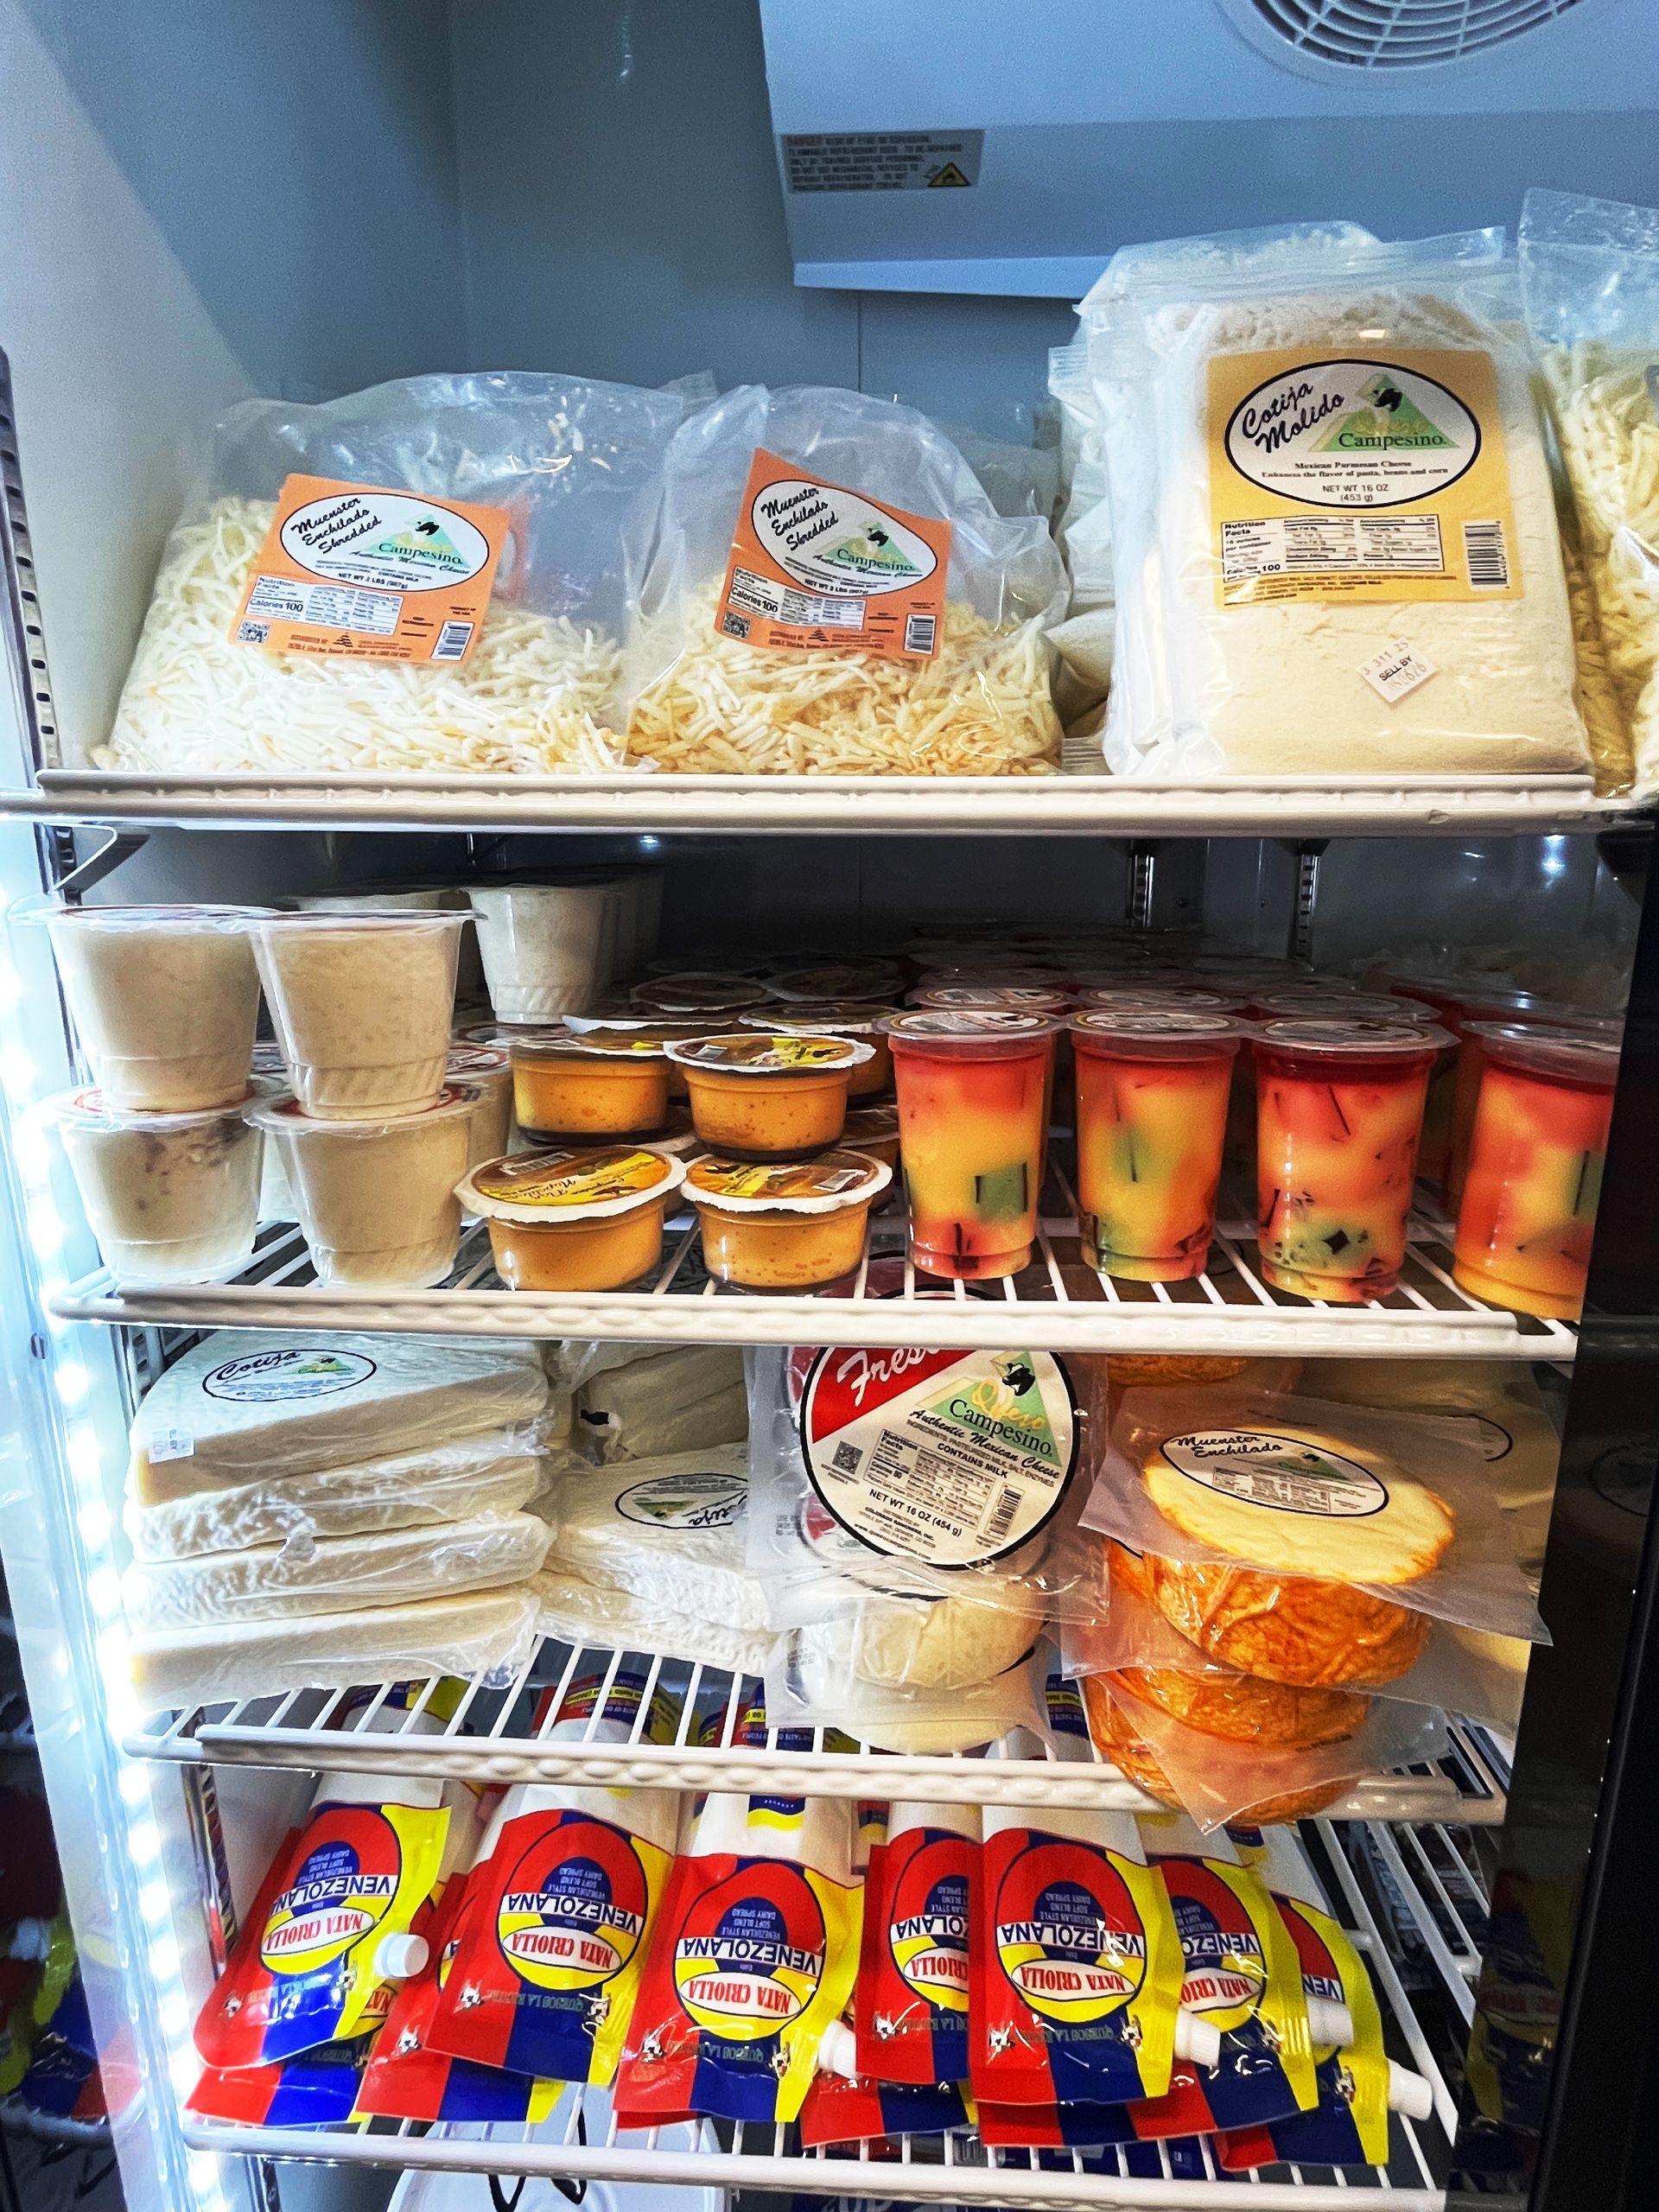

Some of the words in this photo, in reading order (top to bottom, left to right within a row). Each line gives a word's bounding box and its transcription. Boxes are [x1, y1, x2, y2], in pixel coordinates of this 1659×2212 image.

[1242, 381, 1313, 438] Cotija
[1255, 393, 1344, 454] Molido
[1339, 432, 1445, 450] Campesino
[1340, 493, 1362, 503] (453
[1363, 493, 1374, 503] g)
[1362, 484, 1373, 493] 16
[760, 487, 819, 518] Muenster
[291, 498, 360, 534] Muenster
[1224, 520, 1266, 530] Nutrition
[318, 515, 382, 554] Shredded
[786, 512, 839, 551] Shredded
[1225, 528, 1250, 537] Facts
[378, 542, 461, 565] Campesino
[837, 549, 912, 570] Campesino
[338, 572, 351, 581] NET
[353, 574, 365, 582] WT
[372, 576, 385, 586] LBS
[250, 598, 283, 610] Calories
[284, 602, 303, 613] 100
[732, 587, 762, 608] Calories
[762, 600, 779, 613] 100
[1379, 664, 1402, 681] SELL
[1399, 655, 1412, 667] BY
[216, 1351, 301, 1381] Cotija
[950, 1399, 1052, 1457] Campesino
[909, 1408, 966, 1439] Authentic
[969, 1430, 1020, 1463] Mexican
[1021, 1455, 1061, 1479] Cheese
[1171, 1435, 1262, 1447] Muenster
[937, 1442, 984, 1468] CONTAINS
[984, 1463, 1008, 1479] MILK
[1191, 1444, 1283, 1459] Enchilado
[869, 1488, 889, 1503] NET
[889, 1497, 906, 1510] WT
[906, 1504, 917, 1516] 16
[917, 1510, 933, 1523] OZ
[931, 1516, 952, 1533] (454
[951, 1525, 963, 1538] g)
[548, 1884, 567, 1893] STYLE
[560, 1877, 582, 1887] BLEND
[582, 1878, 597, 1889] SOFT
[938, 1886, 961, 1895] SPREAD
[941, 1895, 962, 1904] BLEND
[1045, 1892, 1071, 1903] SPREAD
[1049, 1902, 1071, 1911] BLEND
[1072, 1894, 1091, 1905] DAIRY
[508, 1894, 638, 1932] VENEZOLANA
[731, 1908, 756, 1918] SPREAD
[756, 1910, 776, 1920] DAIRY
[931, 1904, 952, 1913] STYLE
[1039, 1910, 1060, 1921] STYLE
[1071, 1904, 1089, 1915] SOFT
[327, 1913, 364, 1935] NATA
[721, 1926, 741, 1936] STYLE
[734, 1918, 754, 1929] BLEND
[755, 1919, 771, 1929] SOFT
[267, 1920, 321, 1951] CRIOLLA
[512, 1934, 574, 1957] CRIOLLA
[580, 1942, 613, 1969] NATA
[683, 1939, 817, 1976] VENEZOLANA
[1021, 1966, 1083, 1990] CRIOLLA
[1086, 1974, 1124, 1993] NATA
[689, 1980, 751, 2004] CRIOLLA
[1217, 1978, 1253, 1999] NATA
[757, 1990, 791, 2014] NATA
